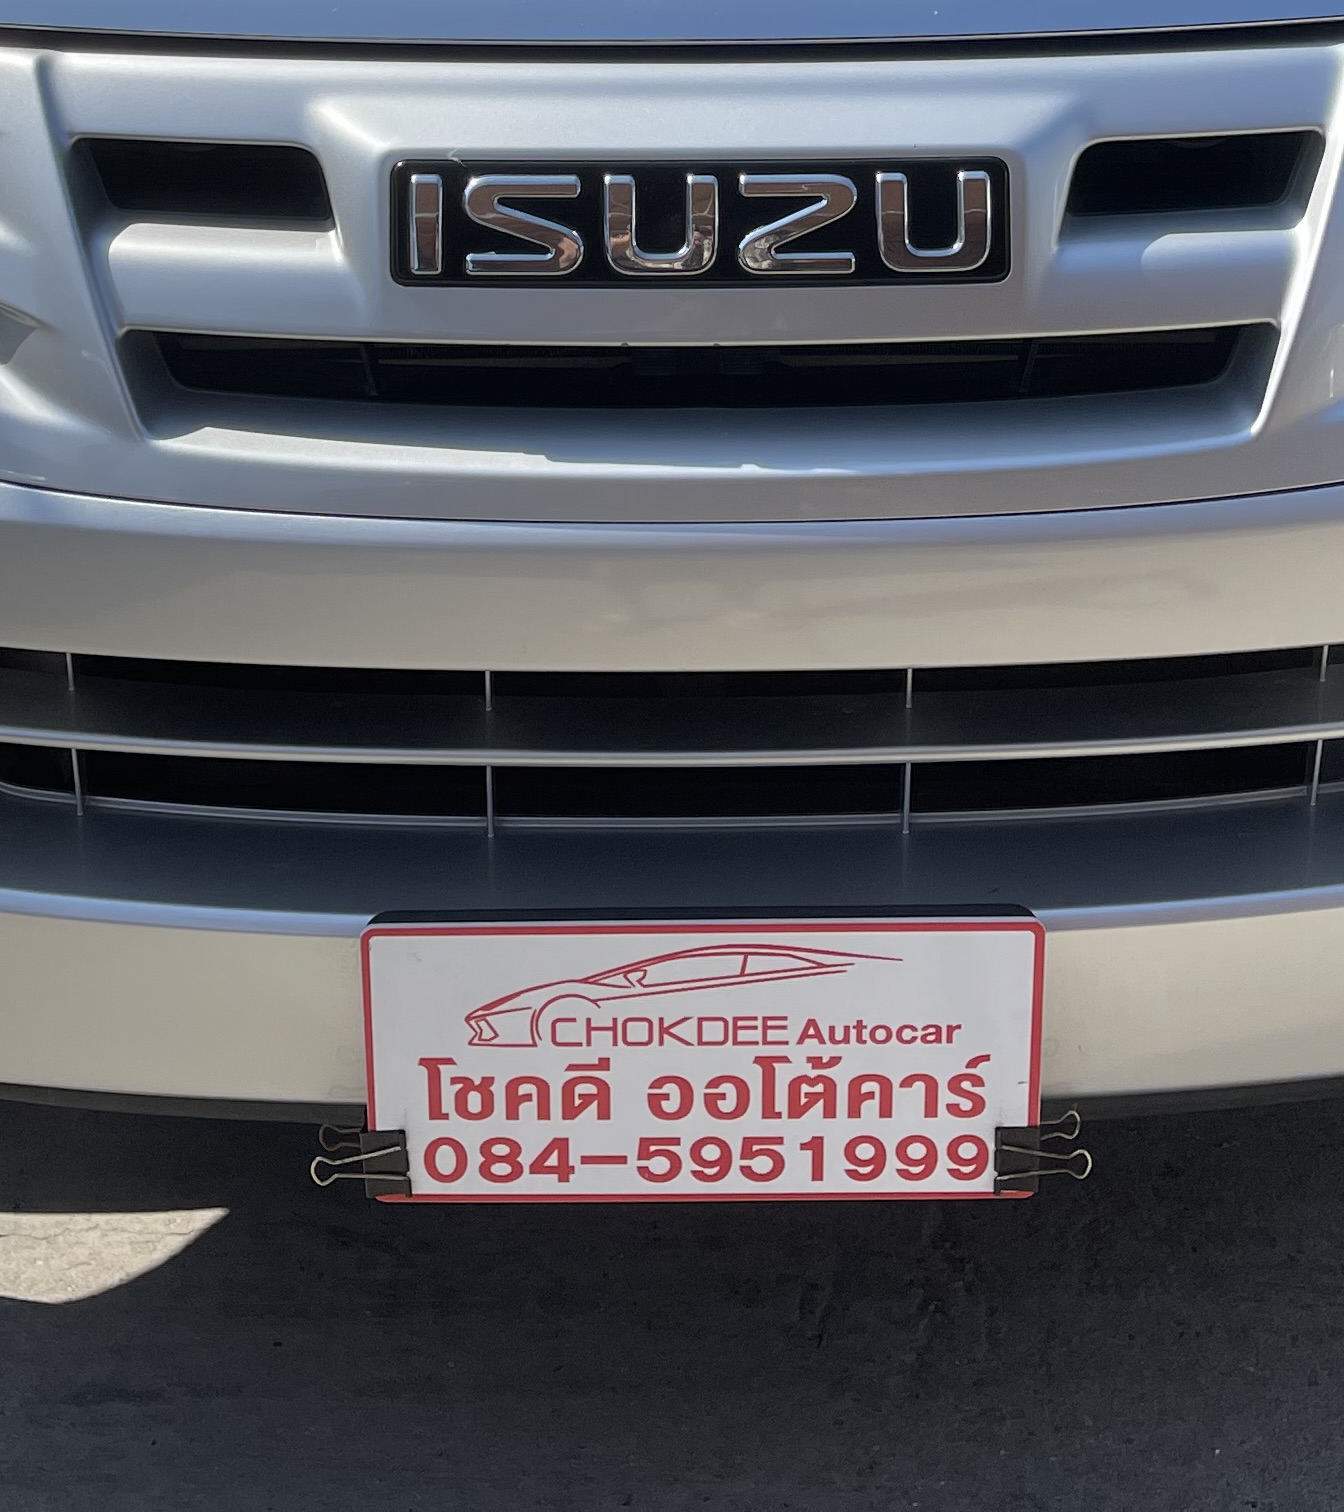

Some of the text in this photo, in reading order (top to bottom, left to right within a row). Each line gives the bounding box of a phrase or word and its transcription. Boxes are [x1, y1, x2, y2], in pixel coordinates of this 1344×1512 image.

[409, 171, 991, 276] ISUZU
[550, 1015, 962, 1047] CHOKDEE Autocar
[418, 1054, 991, 1121] โชคดี ออโต้คาร์
[423, 1134, 989, 1183] 084-5951999
